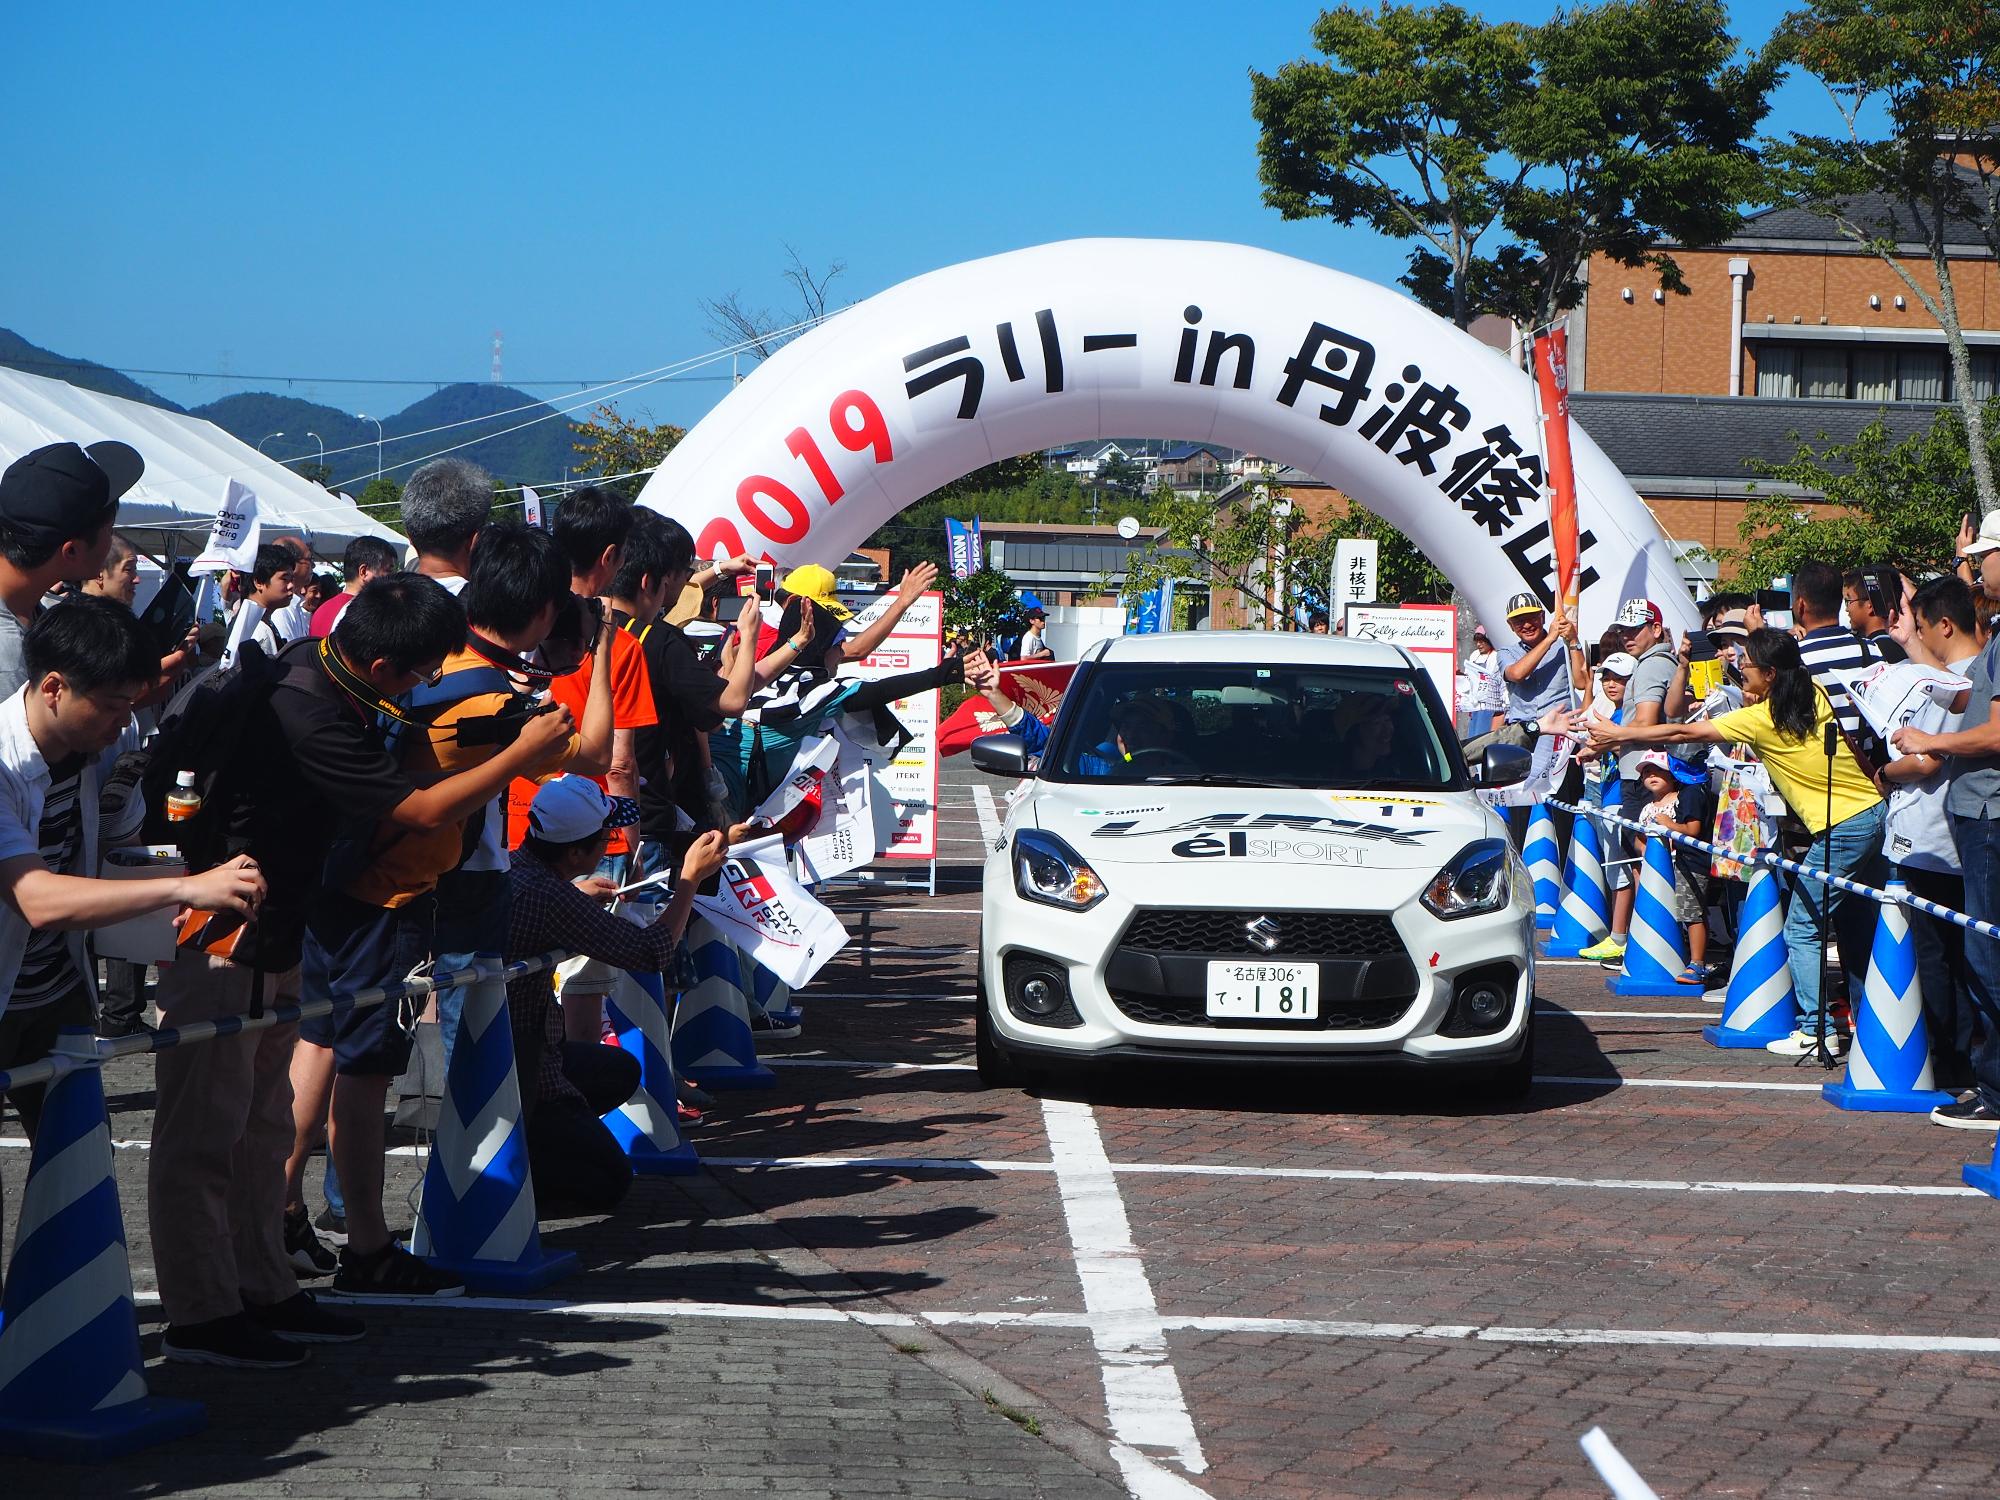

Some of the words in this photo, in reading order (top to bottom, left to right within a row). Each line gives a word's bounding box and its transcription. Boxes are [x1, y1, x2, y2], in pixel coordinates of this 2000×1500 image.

[902, 308, 1137, 420] ラリー
[1174, 304, 1256, 390] in
[1276, 321, 1601, 614] 丹波篠山
[1349, 556, 1367, 600] 非核平
[1356, 622, 1399, 640] Rally
[521, 663, 553, 676] Canon
[896, 772, 921, 780] JTEKT
[1104, 806, 1165, 816] Sammy
[1378, 805, 1425, 818] 11
[898, 820, 914, 828] 3M
[838, 830, 847, 860] AZOO
[844, 829, 853, 863] OYOTA
[1233, 966, 1294, 982] 名古屋306
[1215, 991, 1227, 1006] て
